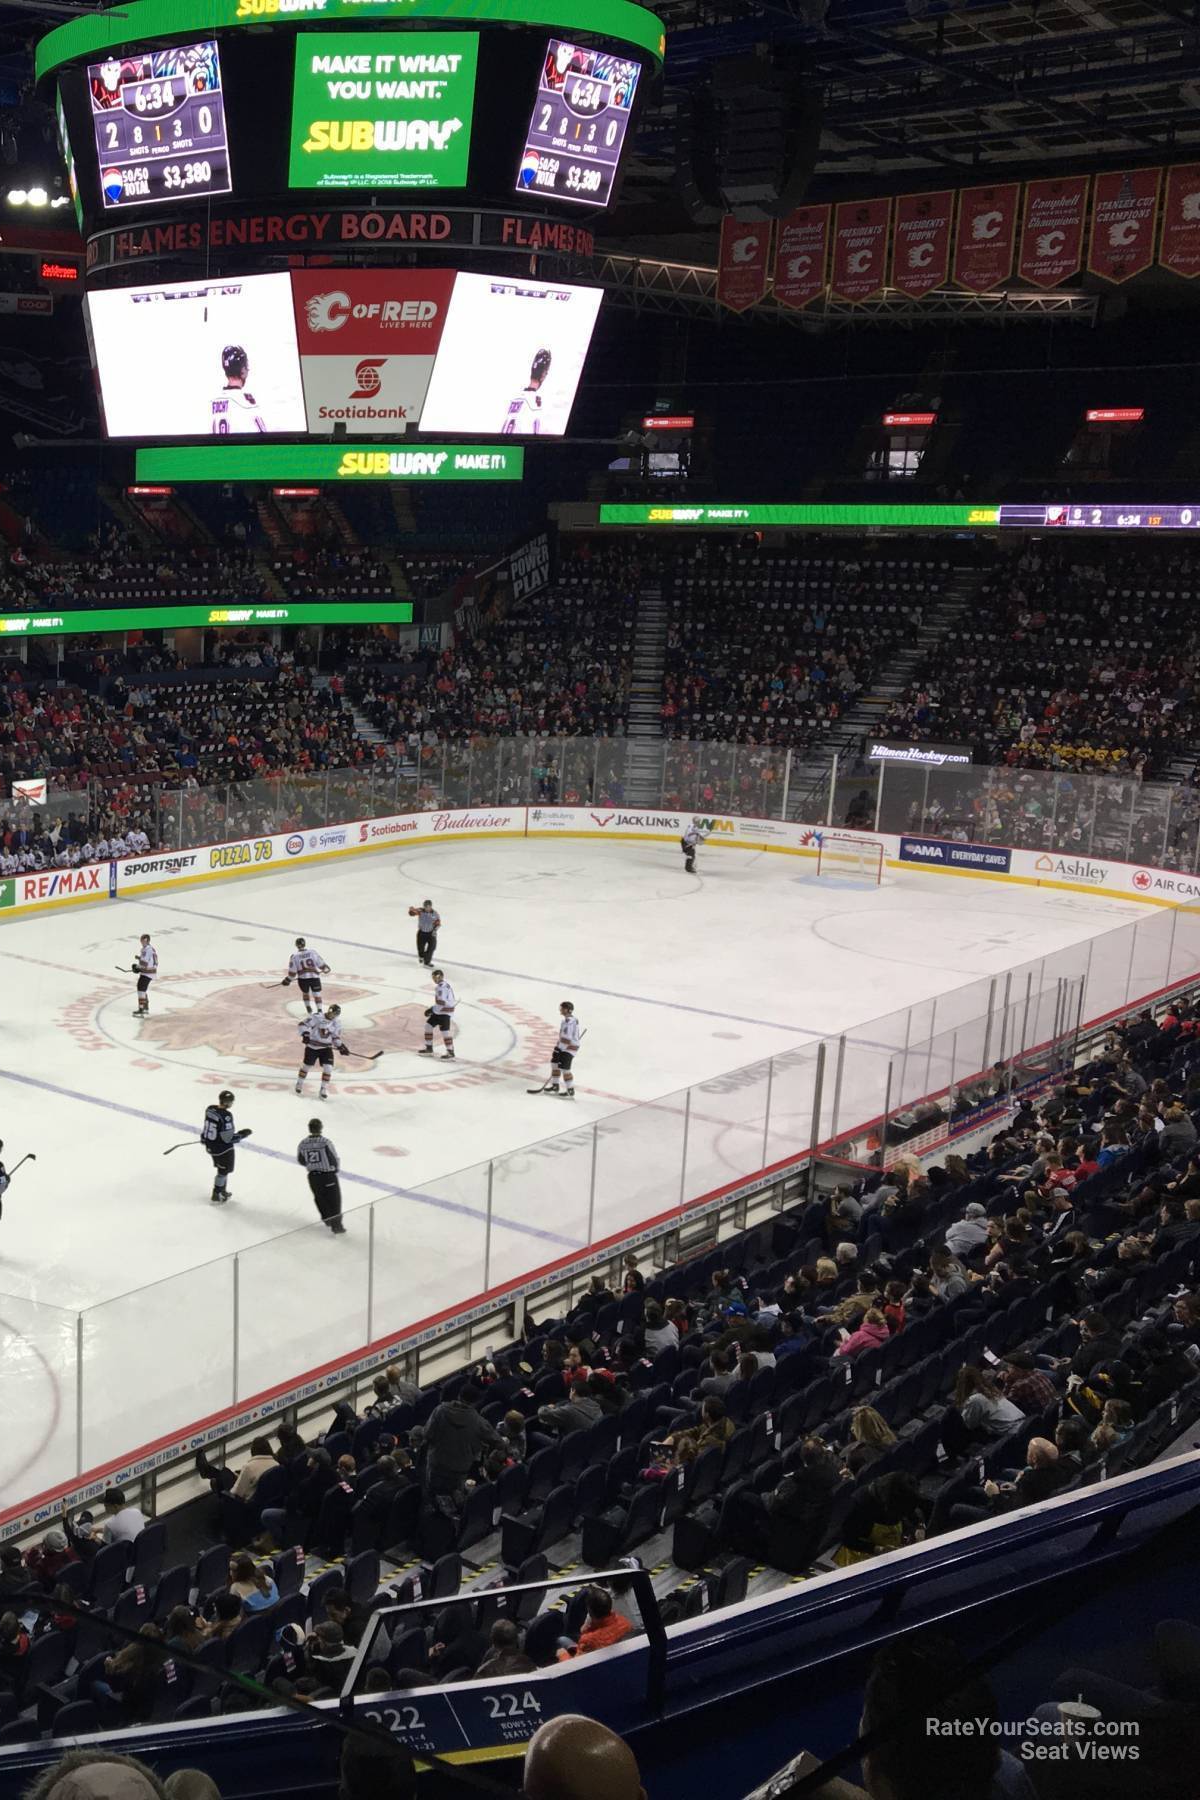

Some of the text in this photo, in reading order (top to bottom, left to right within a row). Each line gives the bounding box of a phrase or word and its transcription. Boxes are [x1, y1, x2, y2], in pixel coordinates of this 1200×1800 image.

[312, 55, 462, 73] MAKE IT WHAT
[135, 81, 175, 112] 6:34
[327, 81, 371, 99] YOU
[571, 80, 602, 110] 6:34
[106, 122, 119, 148] 2
[133, 126, 143, 143] 8
[173, 119, 182, 137] 3
[198, 106, 212, 133] 0
[538, 104, 552, 131] 2
[560, 117, 568, 134] 8
[588, 124, 596, 141] 3
[606, 120, 617, 146] 0
[302, 117, 462, 153] SUBWAY
[552, 137, 567, 147] SHOTS
[129, 146, 149, 156] SHOTS
[173, 139, 193, 149] SHOTS
[122, 161, 211, 189] 50/50 $3,380
[535, 170, 555, 187] TOTAL
[539, 157, 601, 191] 50/50 $3,380
[123, 182, 150, 196] TOTAL
[1032, 193, 1081, 210] Campbell
[1028, 216, 1080, 229] Champions
[1097, 209, 1151, 222] CHAMPIONS
[116, 223, 201, 257] FLAMES
[209, 213, 331, 247] ENERGY
[339, 212, 452, 240] BOARD
[501, 217, 574, 251] FLAMES
[352, 304, 380, 318] OF
[382, 301, 438, 321] RED
[380, 321, 405, 329] LIVES
[318, 406, 407, 419] Scotiabank
[337, 451, 449, 476] SUBWAY
[455, 454, 490, 469] MAKE
[1073, 509, 1081, 518] 8
[1092, 510, 1102, 523] 2
[1117, 515, 1141, 526] 6:34
[1180, 509, 1192, 524] 0
[510, 543, 549, 580] POWER
[514, 563, 550, 600] PLAY
[869, 745, 969, 765] HitmenHockey.com
[371, 821, 418, 837] Scotiabank
[431, 813, 511, 832] Budweiser
[615, 814, 680, 828] JACK LINK'S
[319, 834, 346, 847] Synergy
[210, 840, 273, 868] PIZZA 73
[912, 845, 1006, 865] AMA EVERYDAY SAVES
[124, 855, 197, 876] SPORTSNET
[1054, 859, 1109, 883] Ashley
[24, 869, 100, 900] RE/MAX
[1154, 878, 1174, 890] AIR
[308, 1151, 322, 1163] 21
[1, 1523, 21, 1541] FRESH
[482, 1690, 542, 1718] 224
[500, 1720, 526, 1730] ROWS
[502, 1730, 525, 1740] SEATS
